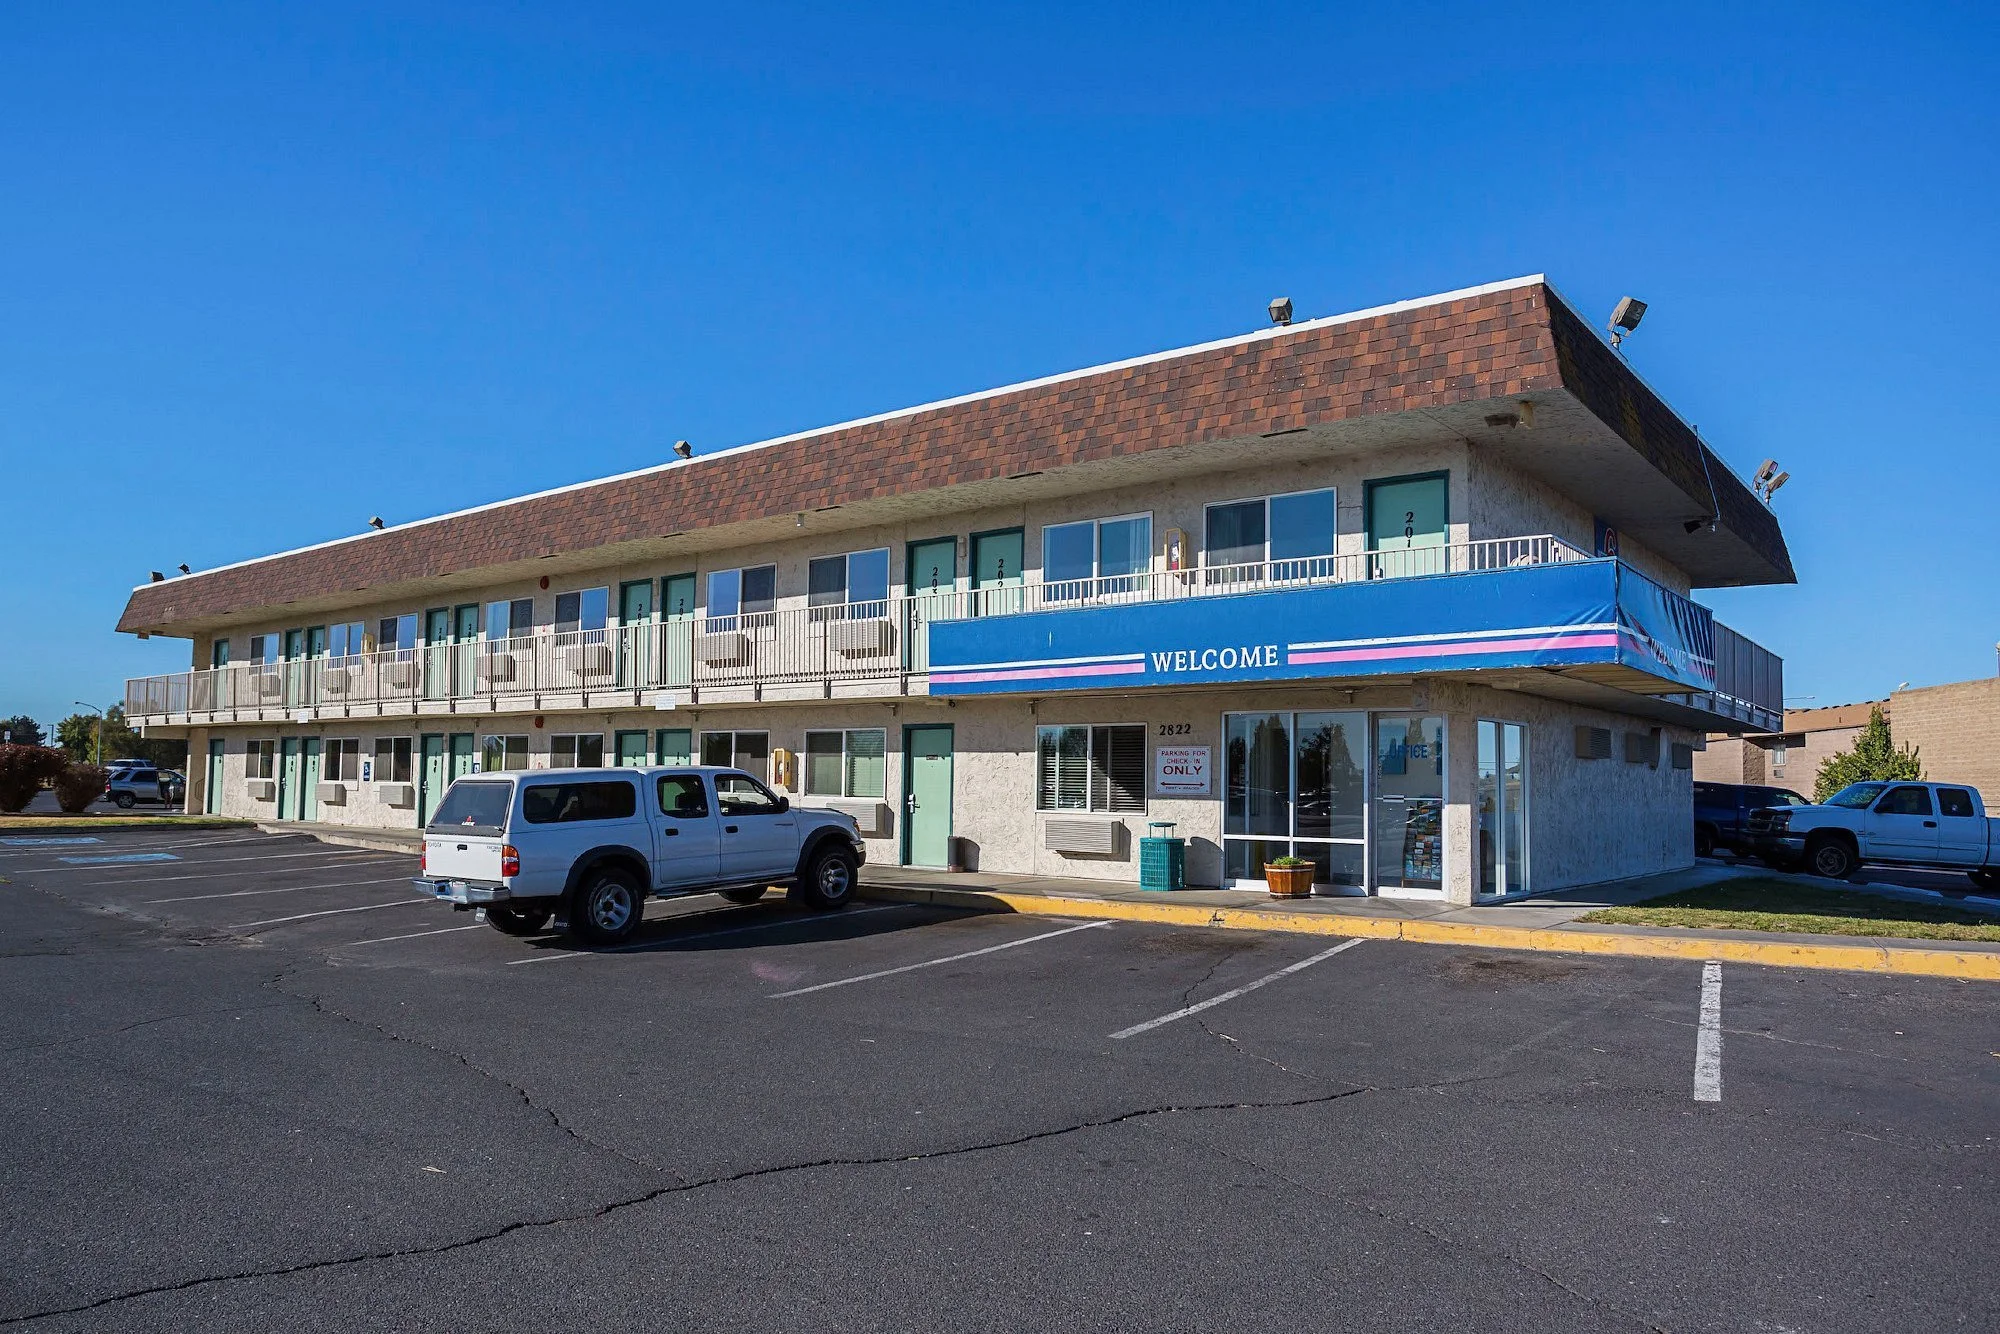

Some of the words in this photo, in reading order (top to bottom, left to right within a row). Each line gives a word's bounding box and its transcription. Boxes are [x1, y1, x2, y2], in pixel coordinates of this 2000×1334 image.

[1405, 511, 1414, 548] 201
[1150, 644, 1279, 673] WELCOME
[1159, 723, 1191, 736] 2822
[1389, 744, 1428, 759] OFFICE
[1162, 765, 1203, 775] ONLY
